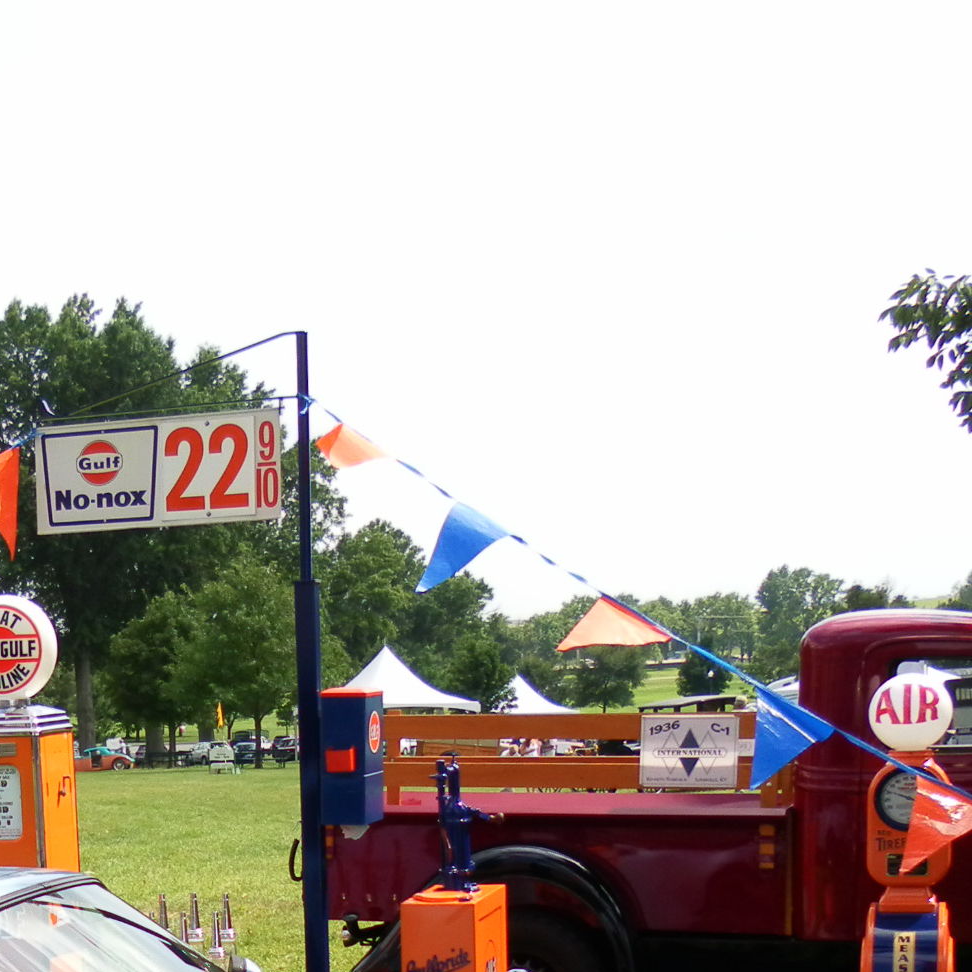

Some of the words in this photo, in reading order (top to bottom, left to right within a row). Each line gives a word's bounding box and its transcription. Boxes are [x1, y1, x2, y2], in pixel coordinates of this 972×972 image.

[258, 420, 275, 461] 9
[78, 456, 121, 472] Gulf
[164, 423, 250, 513] 22
[256, 467, 278, 509] 10
[54, 489, 148, 512] No-nox
[0, 639, 37, 659] GULF
[875, 683, 940, 725] AIR
[649, 720, 680, 736] 1936
[711, 723, 730, 736] C-1
[657, 748, 723, 757] INTERNATIONAL
